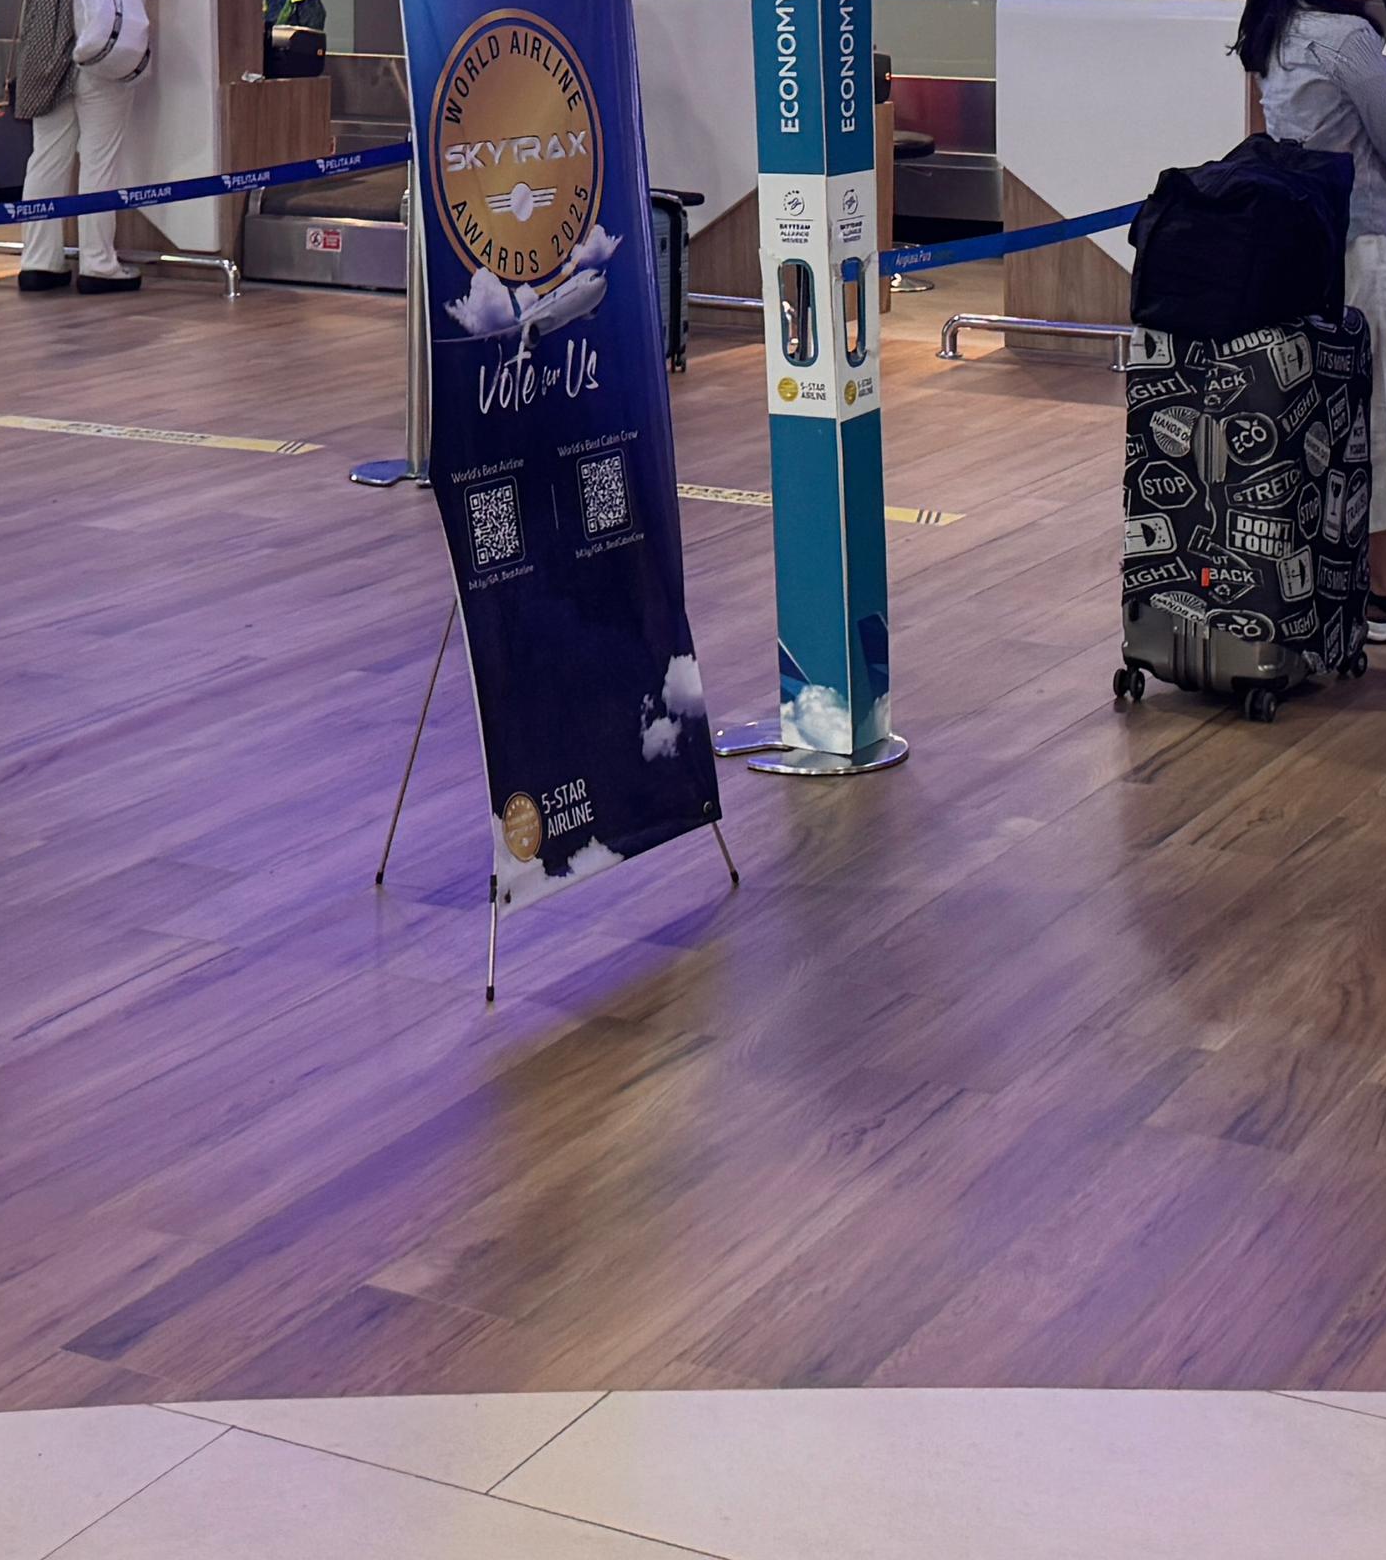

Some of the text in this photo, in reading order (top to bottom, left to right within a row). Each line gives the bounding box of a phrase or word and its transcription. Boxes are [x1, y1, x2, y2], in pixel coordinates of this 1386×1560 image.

[445, 30, 582, 125] WORLD AIRLINE
[445, 130, 588, 173] SKYTRAX
[451, 185, 589, 276] AWARDS 2025
[479, 343, 537, 415] Vote
[565, 338, 599, 398] Us
[1231, 422, 1268, 454] ECO
[1142, 476, 1187, 496] STOP
[1300, 497, 1319, 525] STOP
[1232, 531, 1294, 557] TOUCH
[1125, 563, 1178, 588] LIGHT
[541, 778, 588, 815] 5-STAR
[547, 800, 596, 840] AIRLINE
